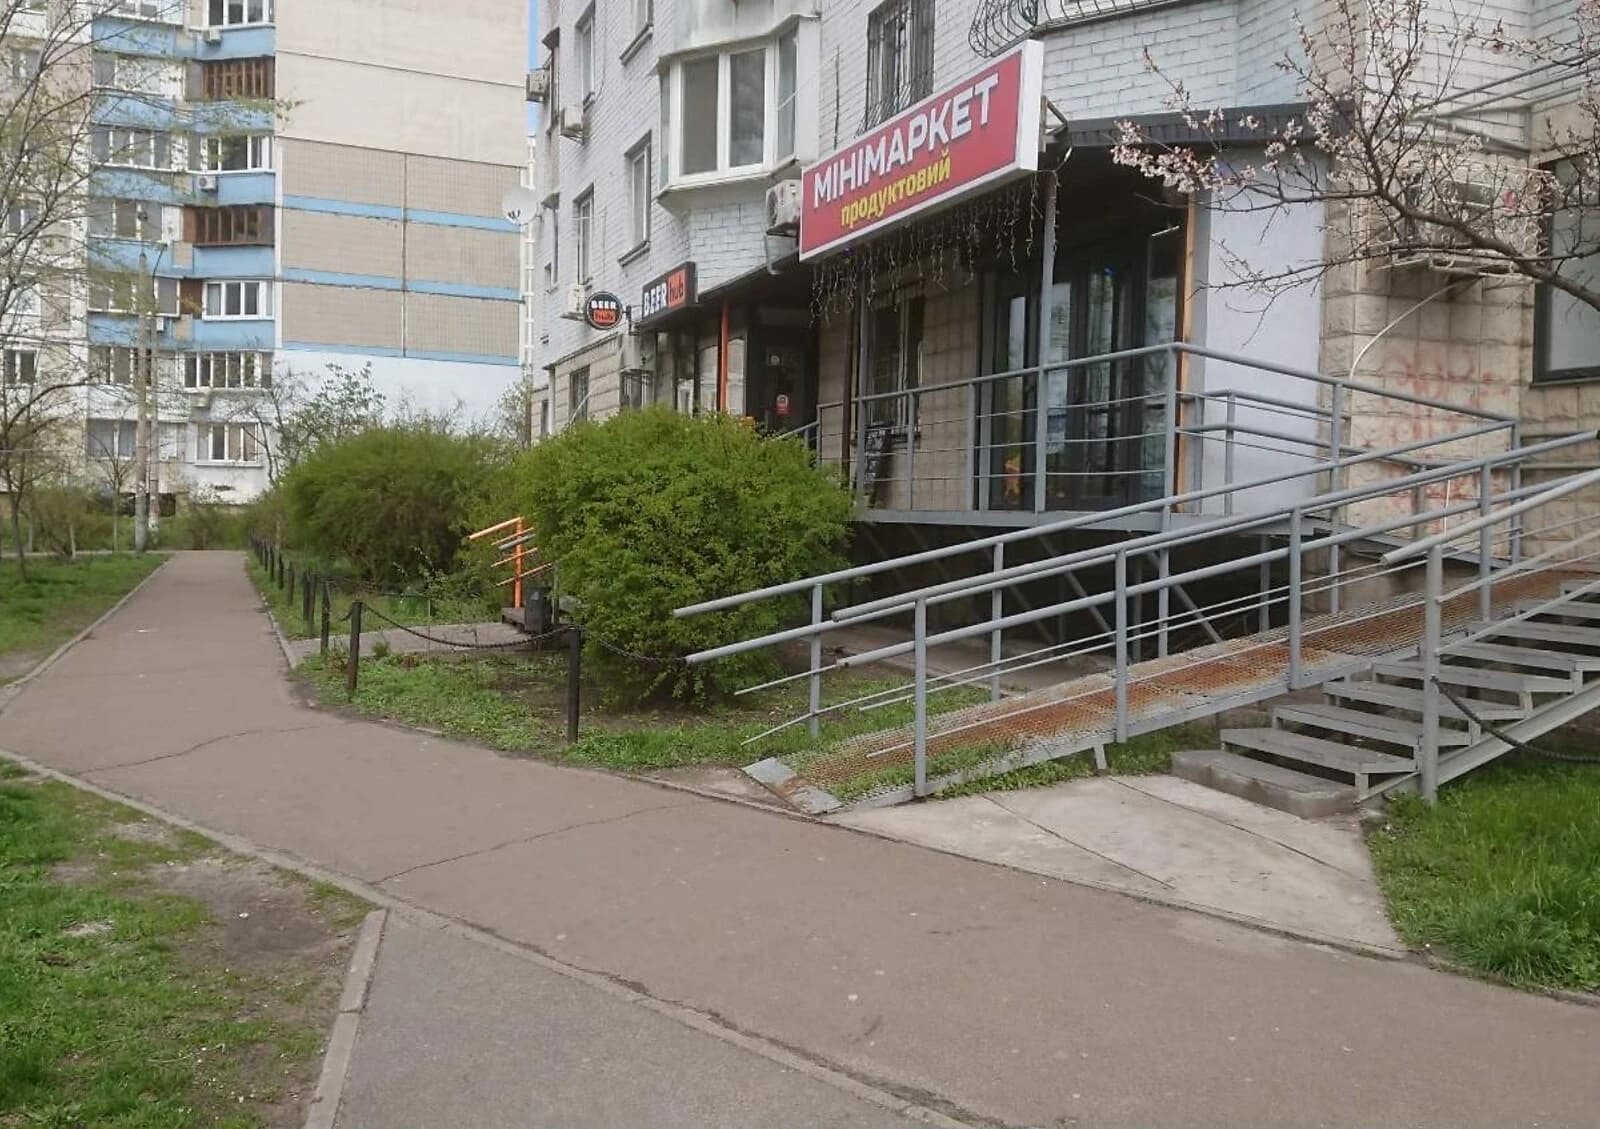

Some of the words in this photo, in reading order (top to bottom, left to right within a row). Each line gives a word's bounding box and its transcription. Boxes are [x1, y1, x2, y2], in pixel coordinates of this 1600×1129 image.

[813, 73, 998, 208] МІНІМАРКЕТ
[841, 149, 950, 229] продуктовий
[591, 300, 616, 310] BEER
[643, 282, 667, 317] BEER
